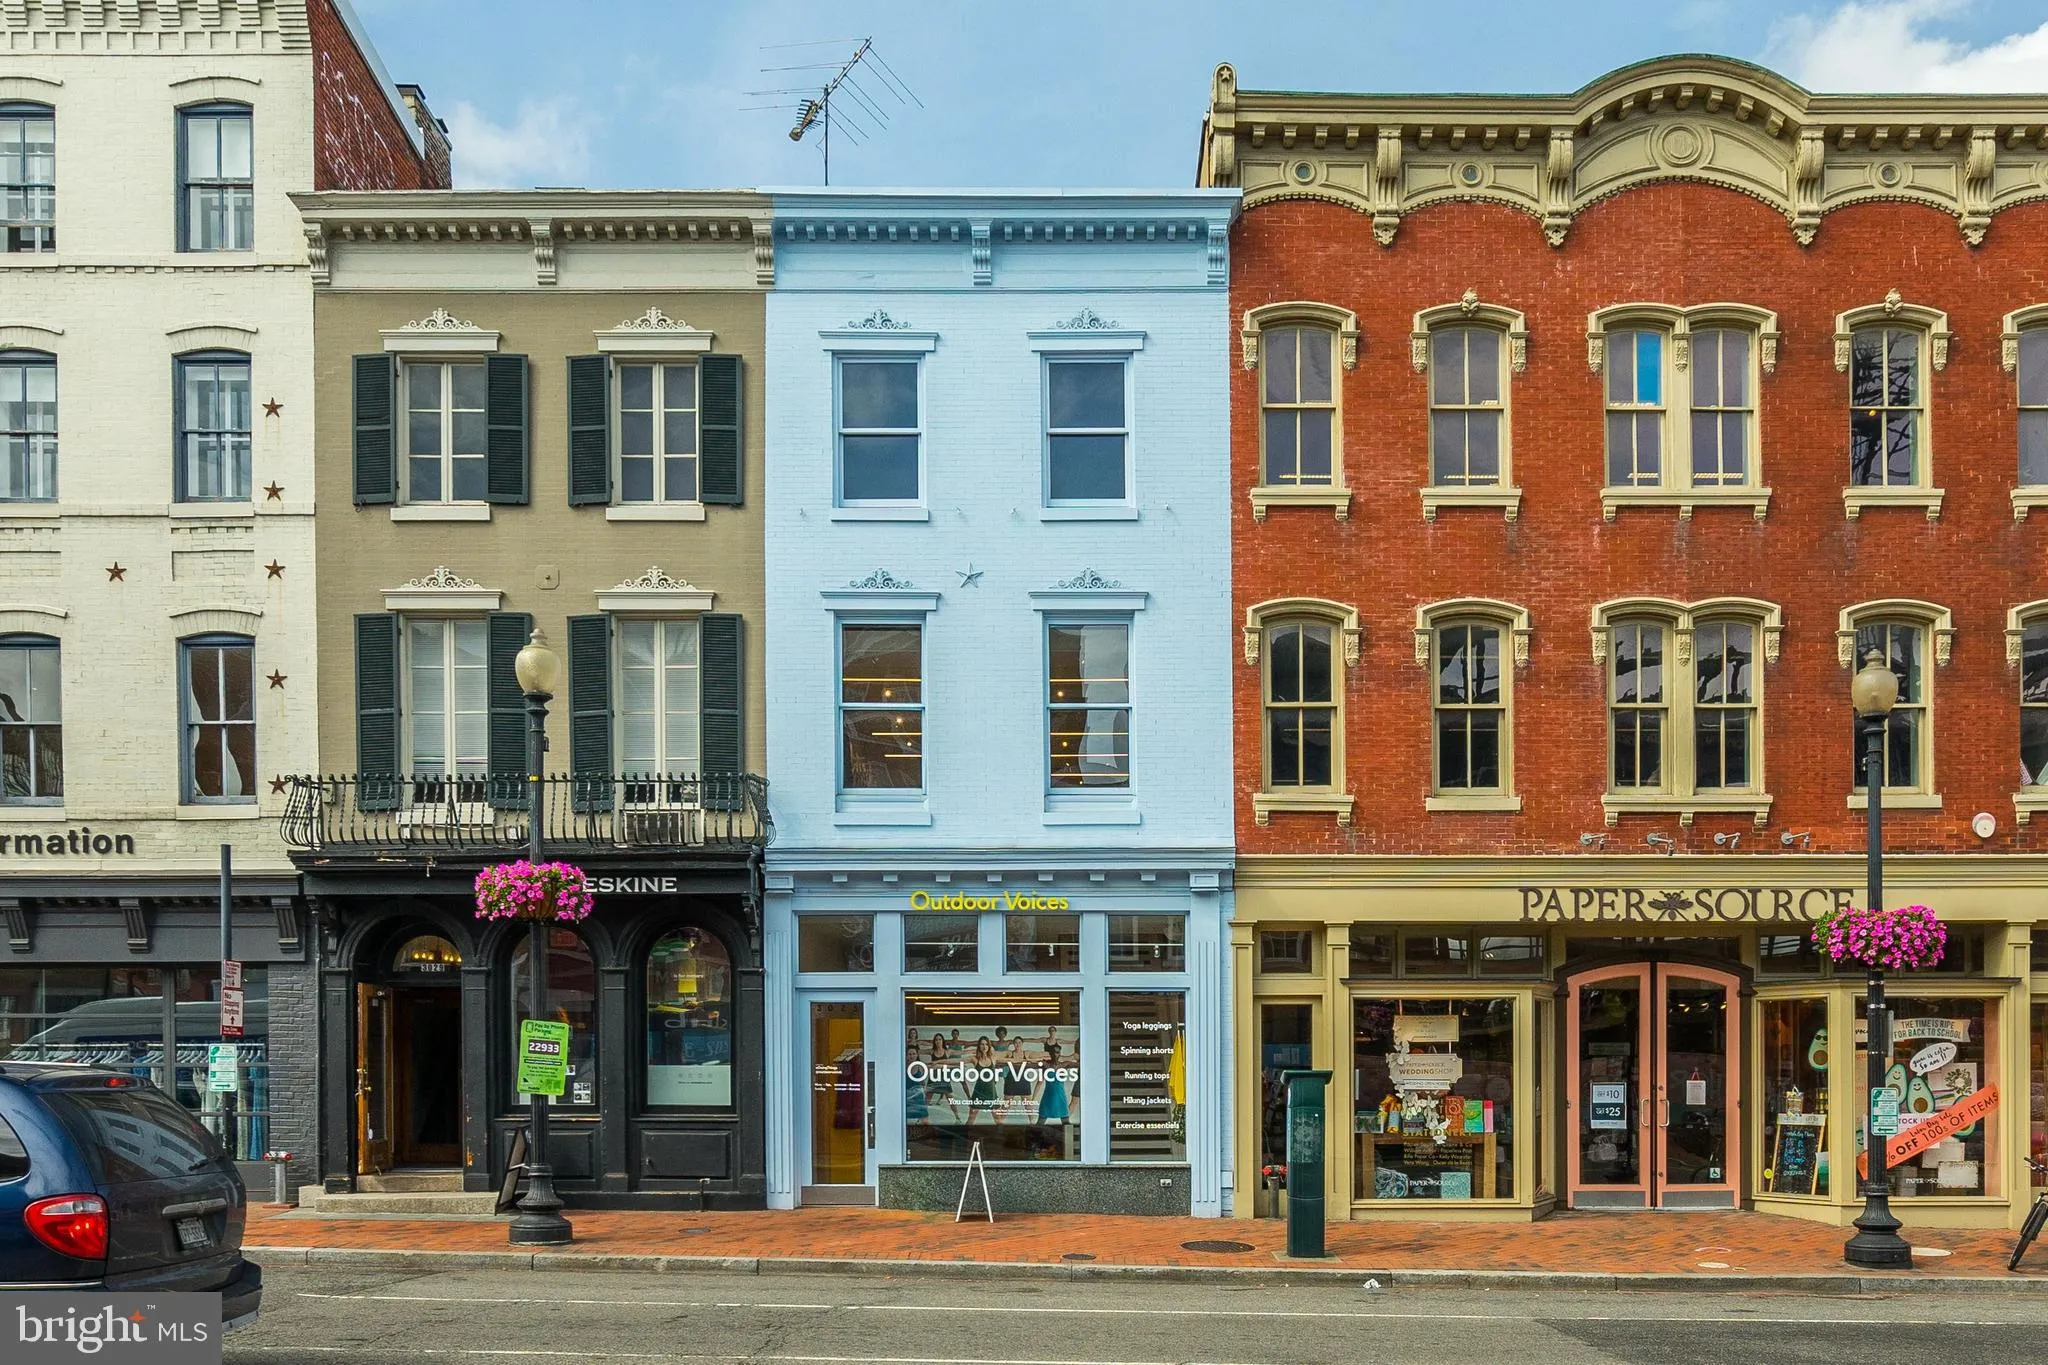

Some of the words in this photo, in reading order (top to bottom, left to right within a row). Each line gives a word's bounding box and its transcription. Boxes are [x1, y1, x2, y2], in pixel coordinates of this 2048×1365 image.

[0, 826, 134, 855] rmation
[909, 890, 1001, 911] Outdoor
[1004, 889, 1069, 911] Voices
[1519, 888, 1650, 922] PAPER
[1694, 888, 1855, 922] SOURCE
[224, 992, 231, 1000] No
[1122, 1022, 1141, 1031] Yoga
[1142, 1022, 1172, 1031] leggings
[1901, 1021, 1914, 1029] THE
[1939, 1020, 1954, 1029] RIPE
[1894, 1031, 1906, 1039] FOR
[1908, 1028, 1925, 1037] BACK
[1927, 1028, 1935, 1036] TO
[1936, 1029, 1961, 1039] SCHOOL
[529, 1042, 560, 1053] 22933
[1120, 1047, 1151, 1056] Spinning
[907, 1061, 1003, 1082] Outdoor
[1007, 1061, 1079, 1082] Voices
[1124, 1072, 1153, 1080] Running
[1154, 1072, 1170, 1080] tops
[948, 1097, 961, 1105] You
[983, 1098, 1010, 1107] anything
[1123, 1097, 1146, 1105] Hiking
[1146, 1097, 1172, 1105] jackets
[1605, 1107, 1621, 1116] $25
[1115, 1121, 1145, 1129] Exercise
[1146, 1121, 1179, 1129] essentials
[1895, 1138, 1919, 1155] OFF
[1922, 1125, 1949, 1142] 100s
[1949, 1112, 1965, 1127] OF
[1967, 1091, 1999, 1117] ITEMS
